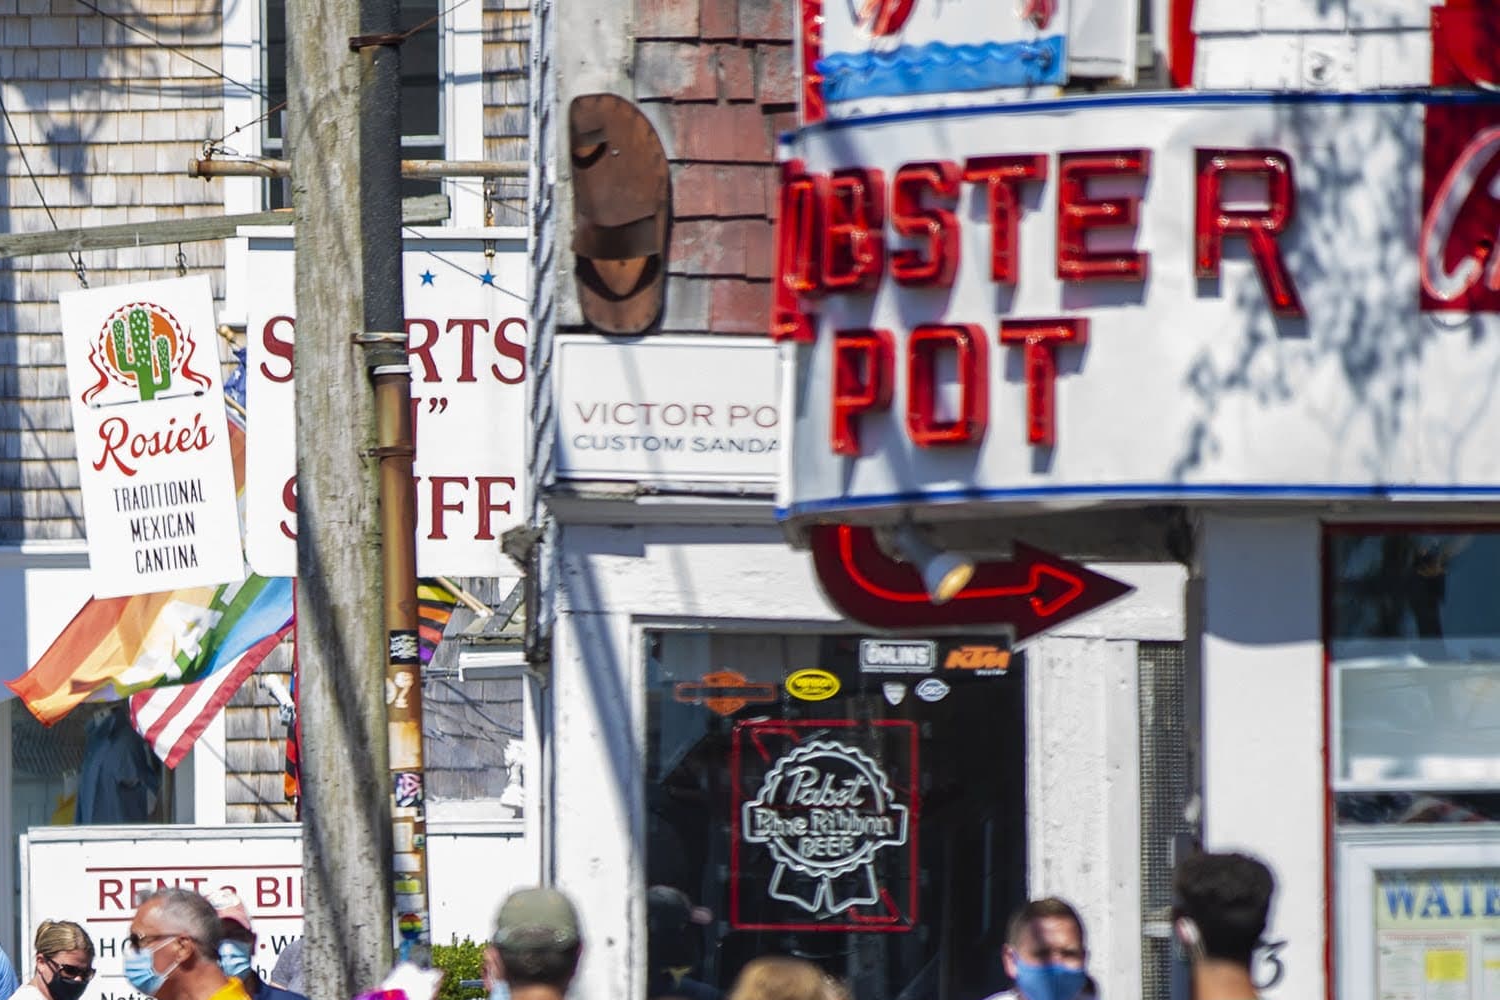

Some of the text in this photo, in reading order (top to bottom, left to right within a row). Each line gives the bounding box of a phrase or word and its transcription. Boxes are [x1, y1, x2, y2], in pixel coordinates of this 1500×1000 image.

[260, 315, 528, 384] SRTS
[830, 318, 1088, 455] POT
[574, 402, 779, 428] VICTOR PO
[92, 412, 215, 477] Rosie's
[573, 434, 682, 451] CUSTOM
[113, 478, 206, 513] TRADITIONAL
[130, 511, 196, 543] MEXICAN
[135, 543, 199, 574] CANTINA
[786, 766, 870, 806] Pabst
[256, 876, 304, 908] BI
